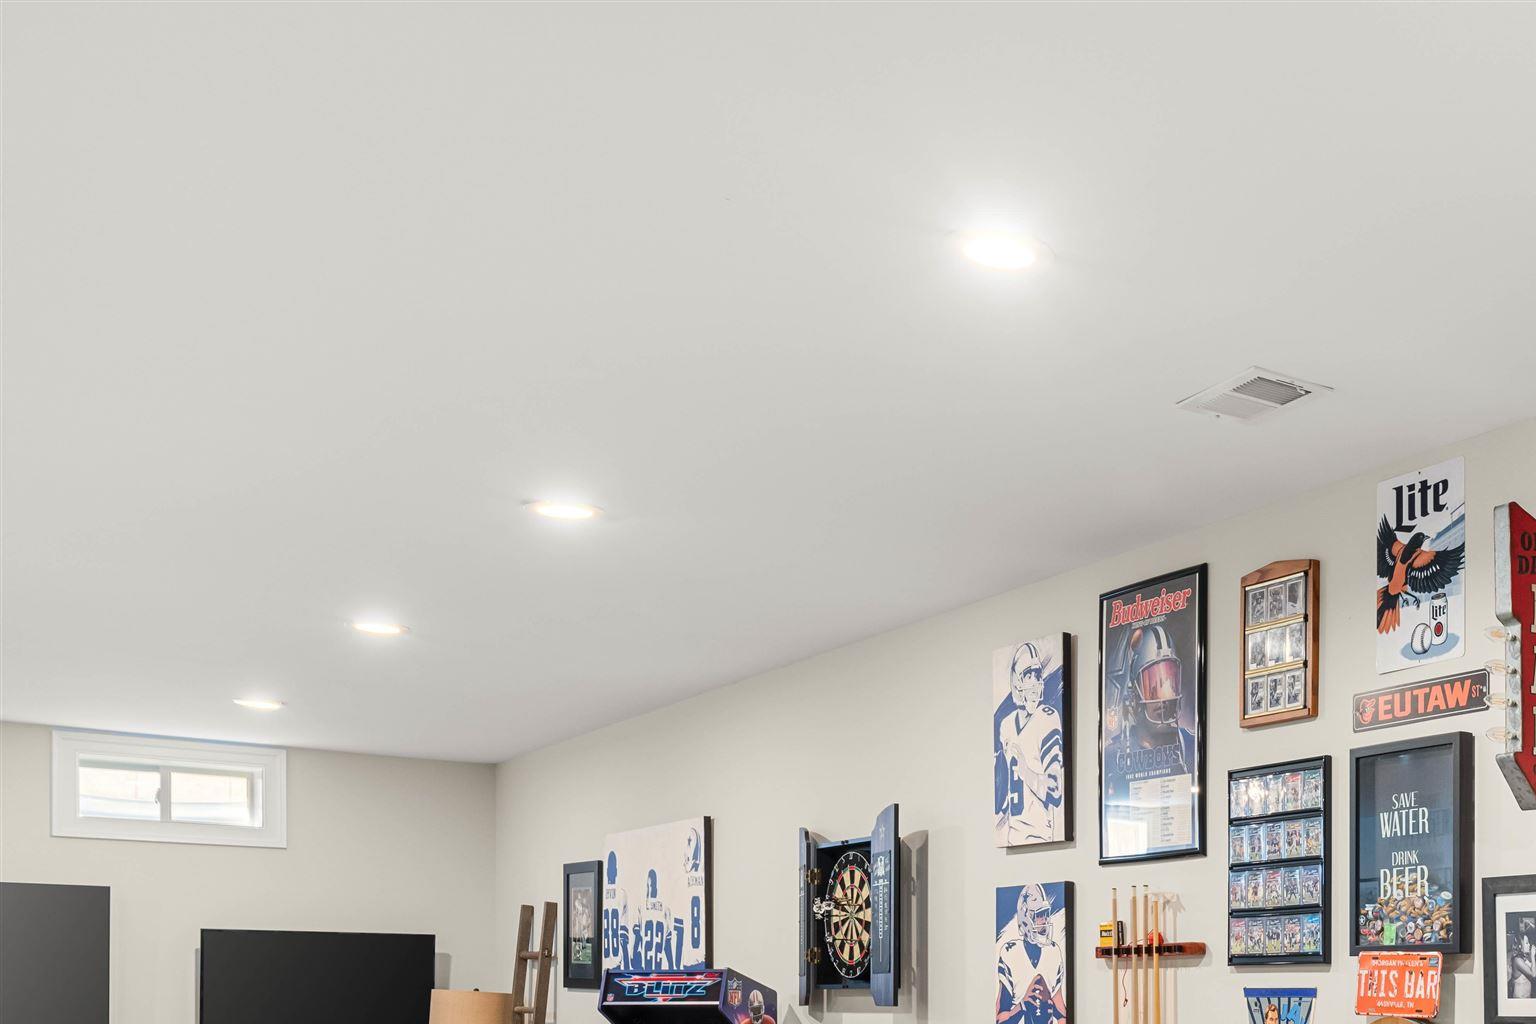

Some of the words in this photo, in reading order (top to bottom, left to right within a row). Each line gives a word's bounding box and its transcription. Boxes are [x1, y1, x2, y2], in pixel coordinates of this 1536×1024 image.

[1392, 478, 1449, 532] Lite
[1109, 588, 1192, 628] Budweiser
[1431, 604, 1446, 621] Lite
[1378, 679, 1471, 721] EUTAW
[1116, 744, 1182, 774] COWBOYS
[1392, 791, 1418, 809] SAVE
[1380, 807, 1430, 838] WATER
[1391, 850, 1419, 866] DRINK
[1380, 865, 1429, 900] BEER
[1360, 969, 1399, 998] THIS
[1404, 970, 1439, 999] BAR
